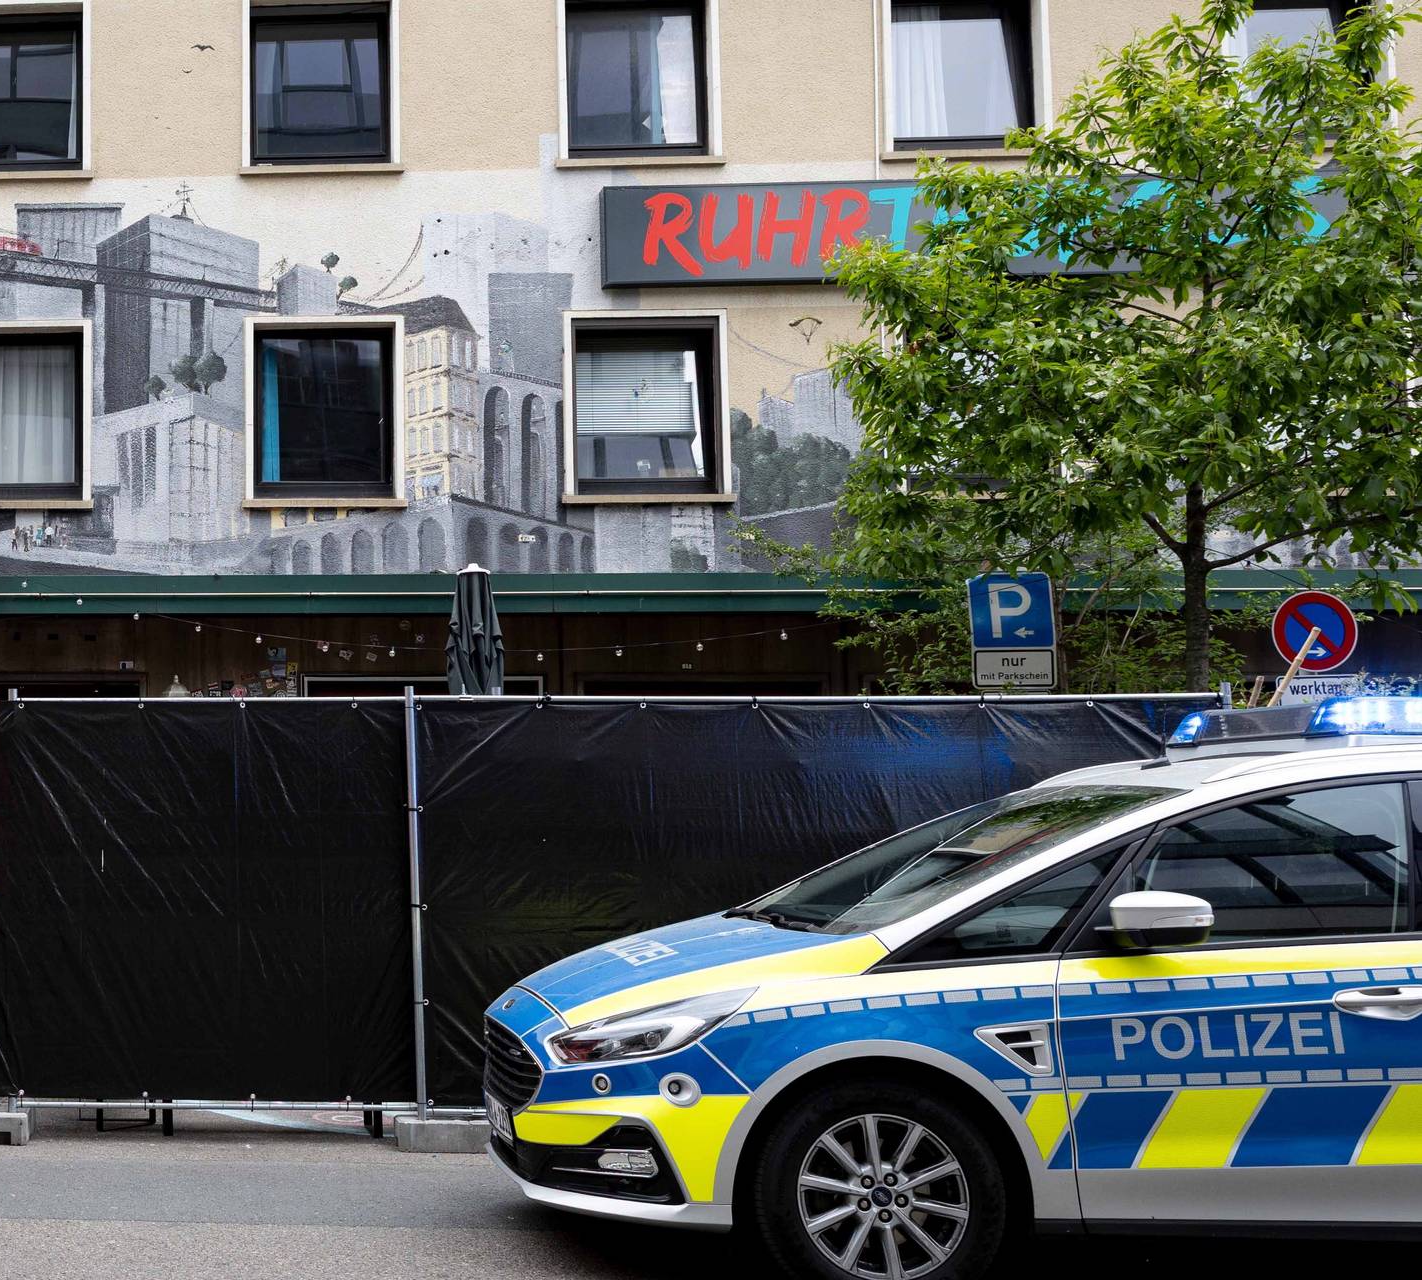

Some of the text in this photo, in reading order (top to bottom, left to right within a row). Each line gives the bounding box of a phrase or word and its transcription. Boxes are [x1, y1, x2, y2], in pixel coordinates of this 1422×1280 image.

[1001, 657, 1027, 667] nur
[980, 672, 1049, 680] mit Parkschein
[1111, 1011, 1346, 1061] POLIZEI
